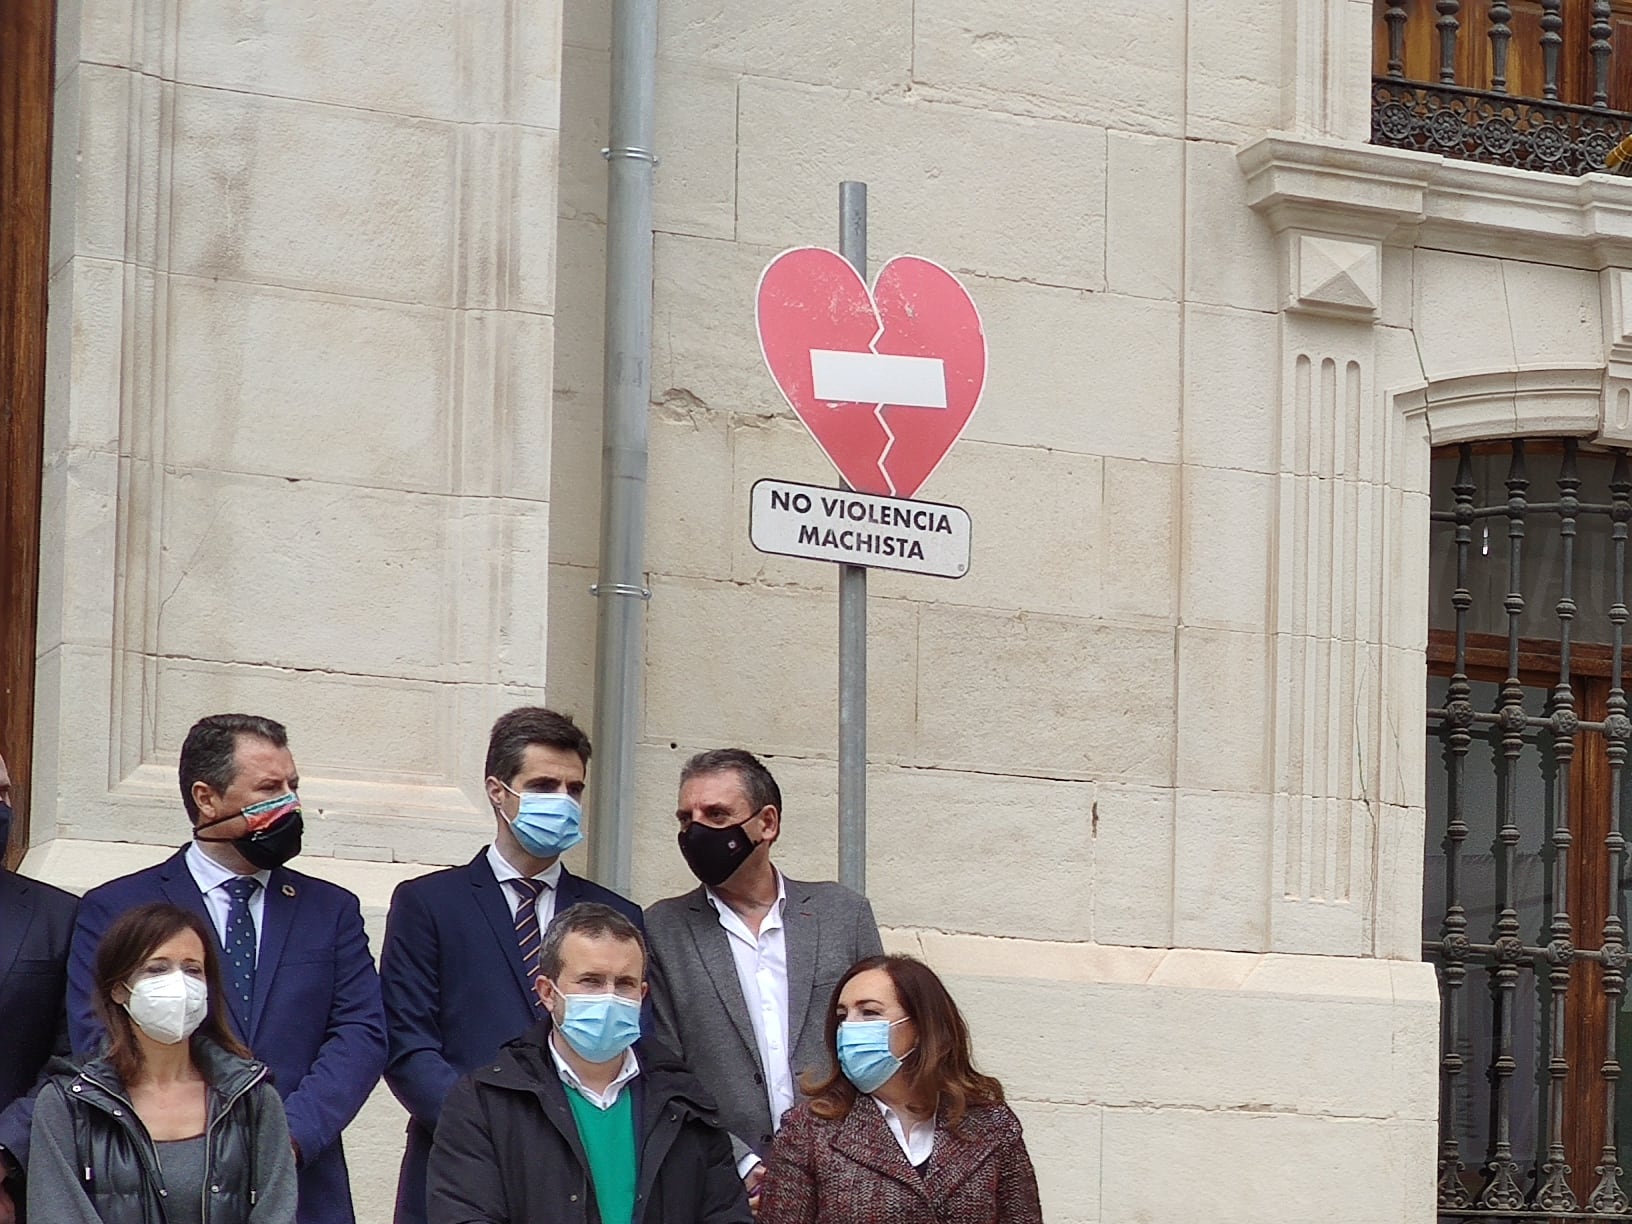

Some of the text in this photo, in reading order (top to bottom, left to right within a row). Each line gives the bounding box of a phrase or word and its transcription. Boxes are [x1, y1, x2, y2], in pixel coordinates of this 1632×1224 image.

[770, 490, 952, 535] NO VIOLENCIA
[798, 524, 925, 560] MACHISTA
